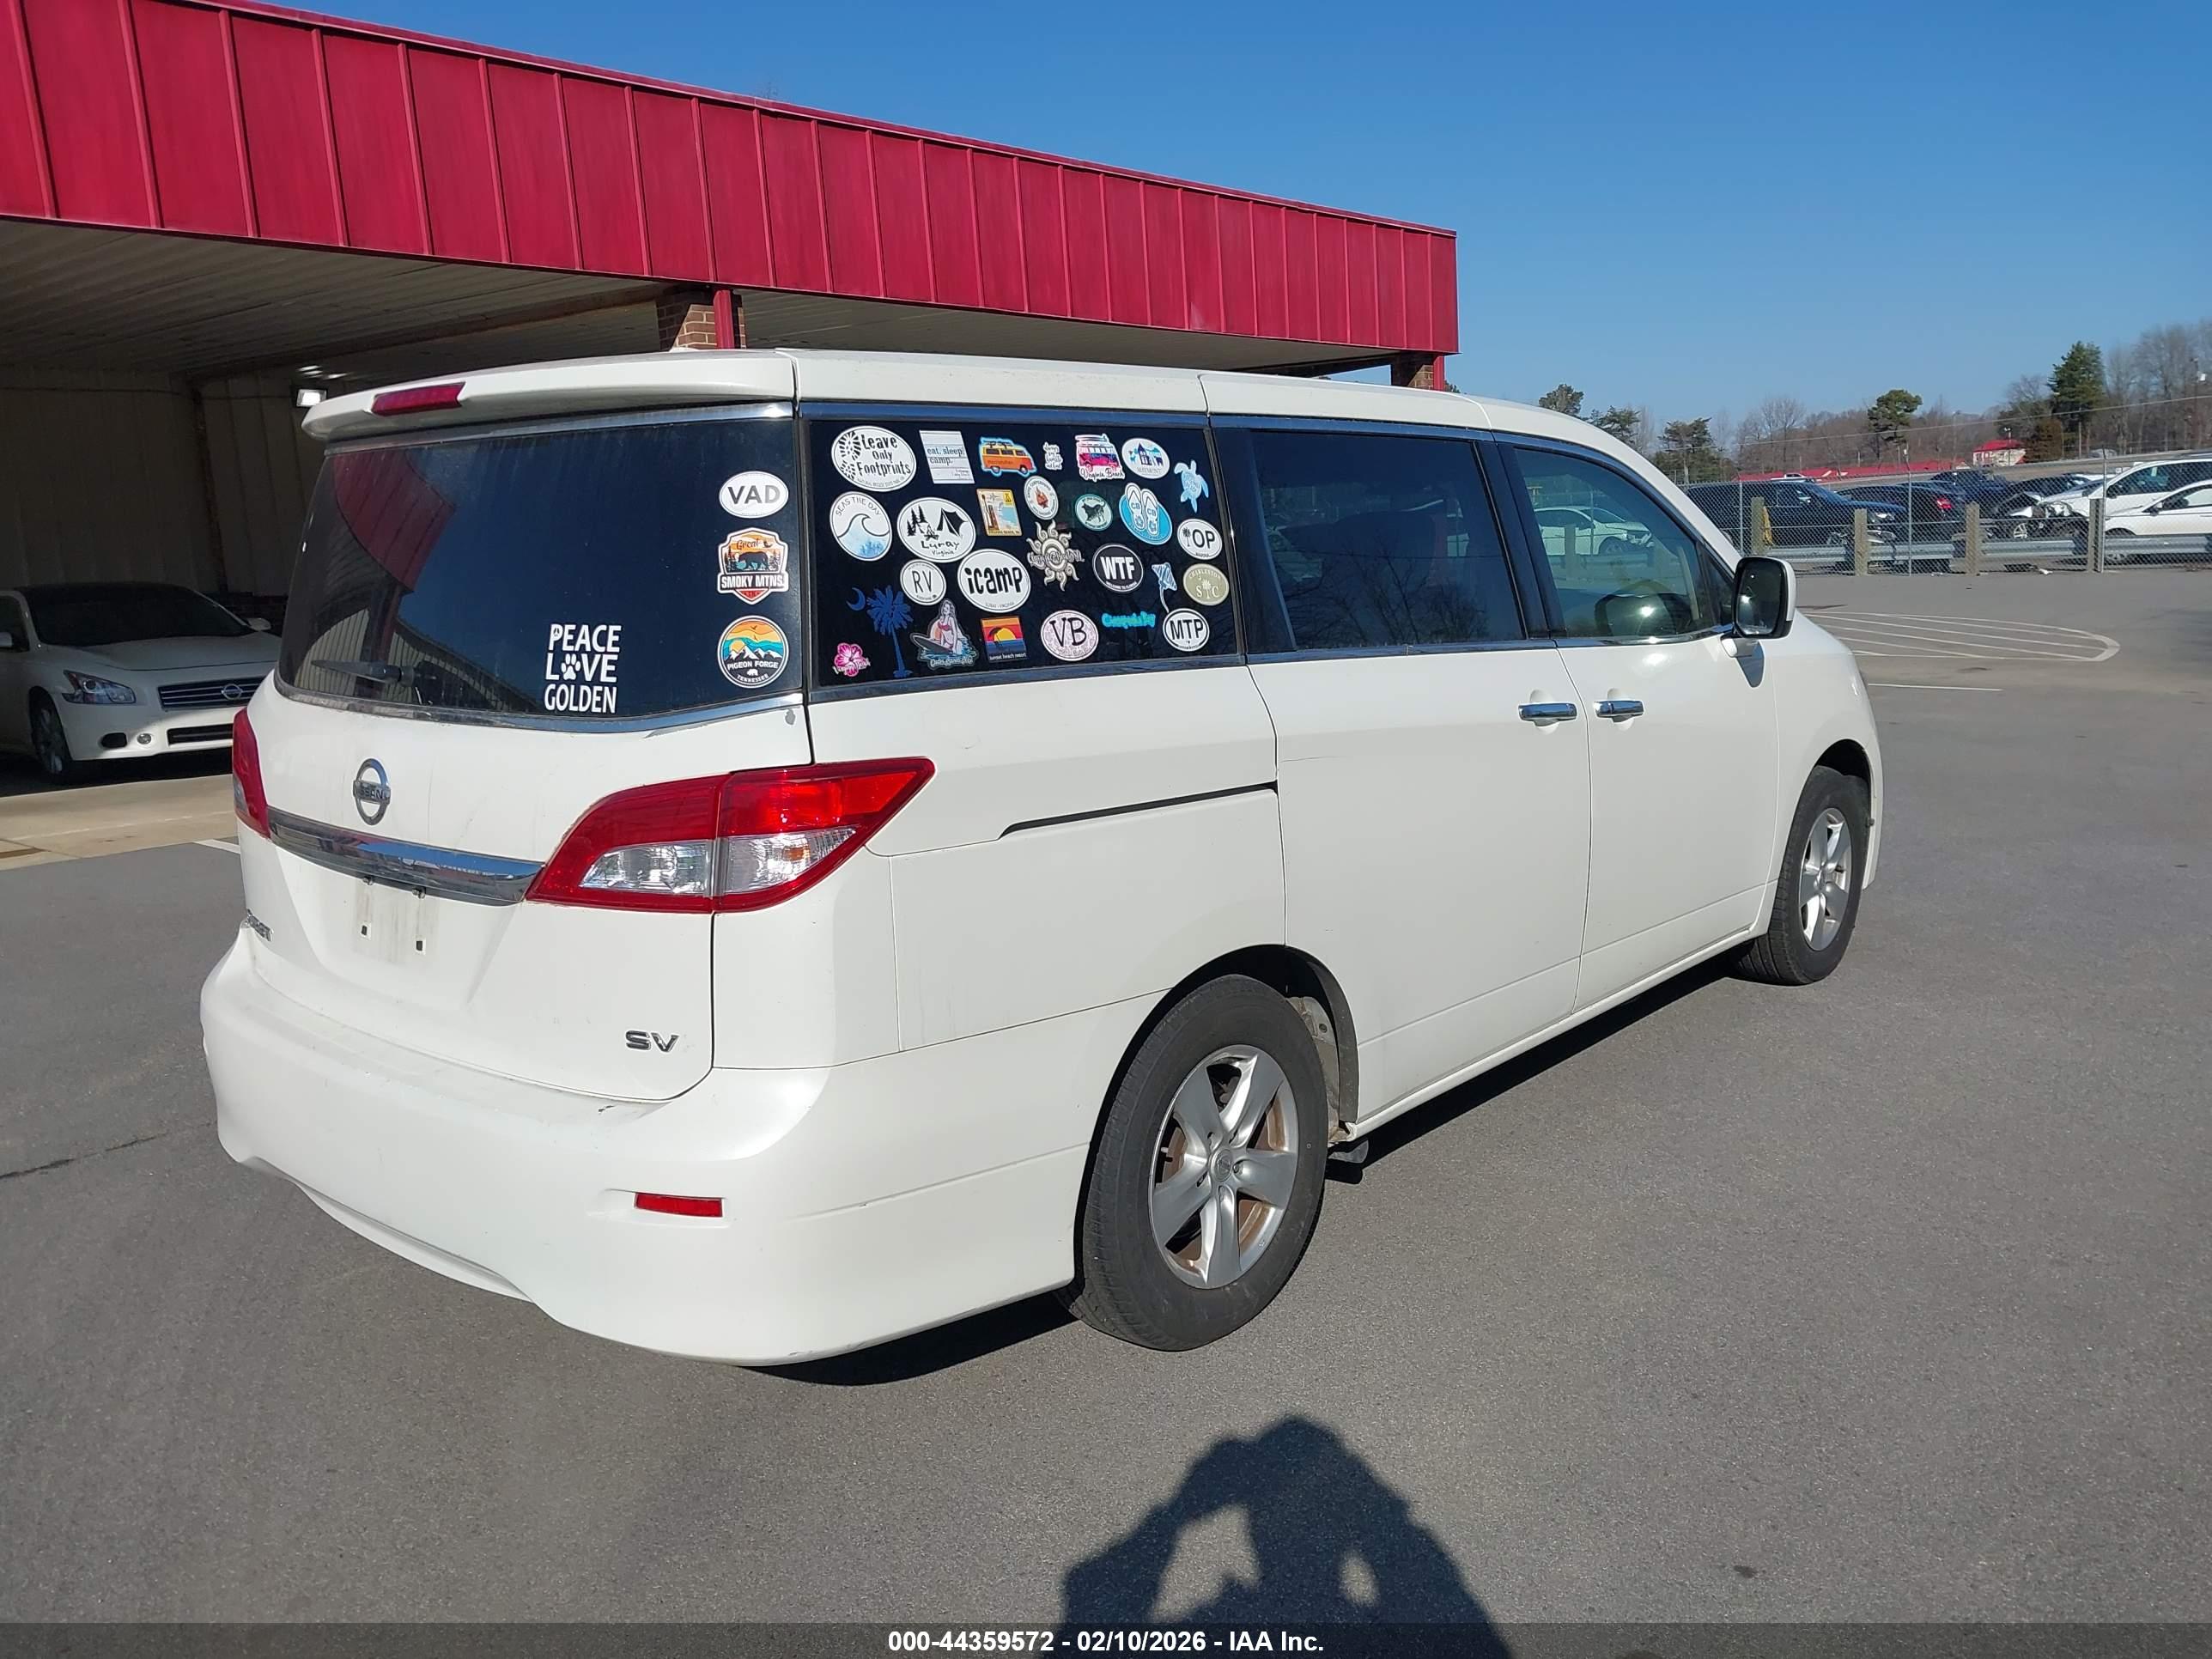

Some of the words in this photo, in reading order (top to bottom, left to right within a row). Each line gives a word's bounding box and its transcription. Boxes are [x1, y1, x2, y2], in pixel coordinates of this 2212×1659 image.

[861, 434, 897, 449] Leave
[872, 449, 892, 463] Only
[857, 460, 910, 477] Footprints
[727, 485, 781, 504] VAD
[836, 498, 850, 515] SEAS
[852, 496, 866, 505] THE
[868, 501, 880, 515] DAY
[736, 538, 760, 550] Great
[921, 540, 960, 550] Luray
[1192, 529, 1215, 549] OP
[1100, 556, 1134, 580] WTF
[721, 575, 753, 589] SMOKY
[912, 570, 932, 593] RV
[964, 567, 1023, 595] icamp
[549, 623, 622, 653] PEACE
[1049, 617, 1086, 647] VB
[1170, 618, 1204, 641] MTP
[545, 653, 618, 683] LVE
[726, 661, 752, 670] PIGEON
[737, 673, 769, 683] TENNESSEE
[544, 684, 617, 714] GOLDEN
[625, 1030, 680, 1052] SV
